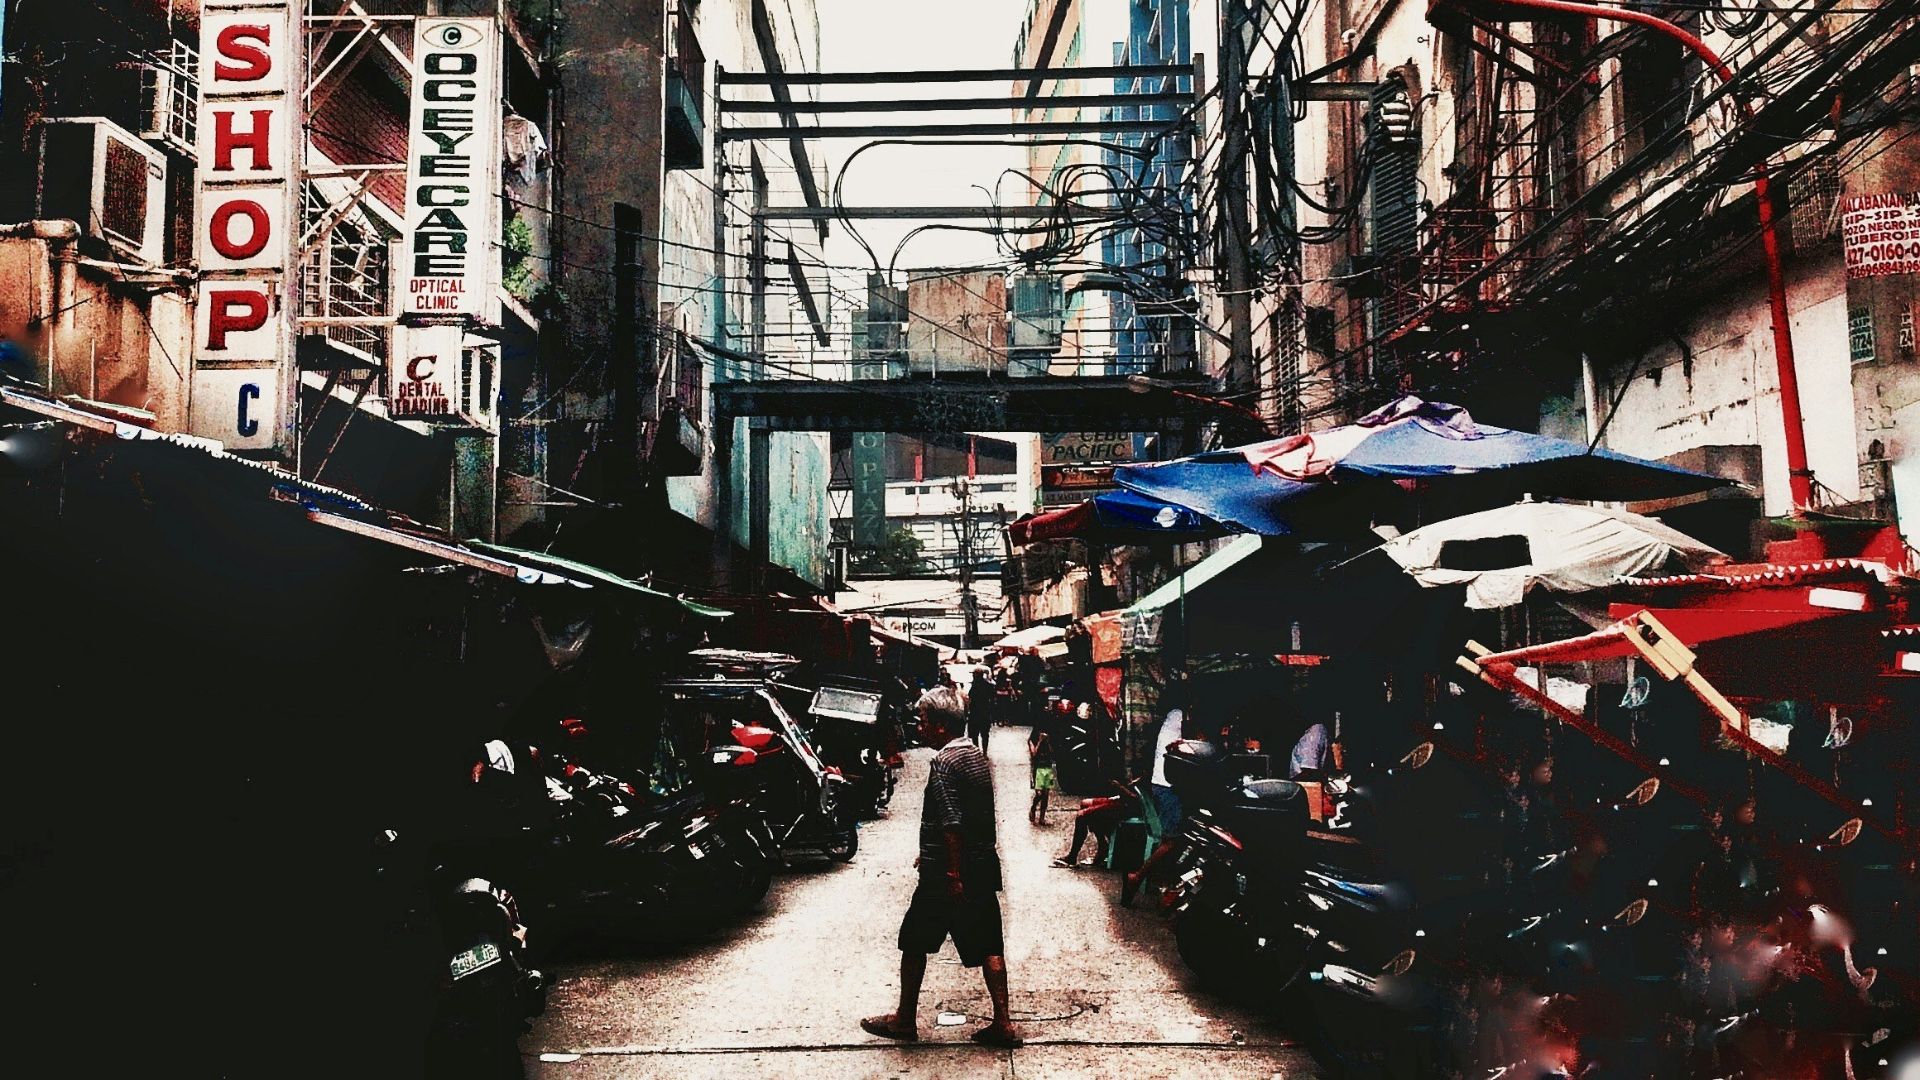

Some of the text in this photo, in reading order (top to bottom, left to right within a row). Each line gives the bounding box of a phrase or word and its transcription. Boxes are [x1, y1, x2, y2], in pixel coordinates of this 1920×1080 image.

[205, 24, 273, 351] SHOP
[1868, 220, 1907, 232] NEGRO
[410, 279, 466, 294] OPTICAL
[416, 295, 459, 310] CLINIC
[406, 355, 438, 382] C
[398, 382, 446, 398] DENTAL
[237, 383, 260, 438] C
[1053, 443, 1126, 461] PACIFIC
